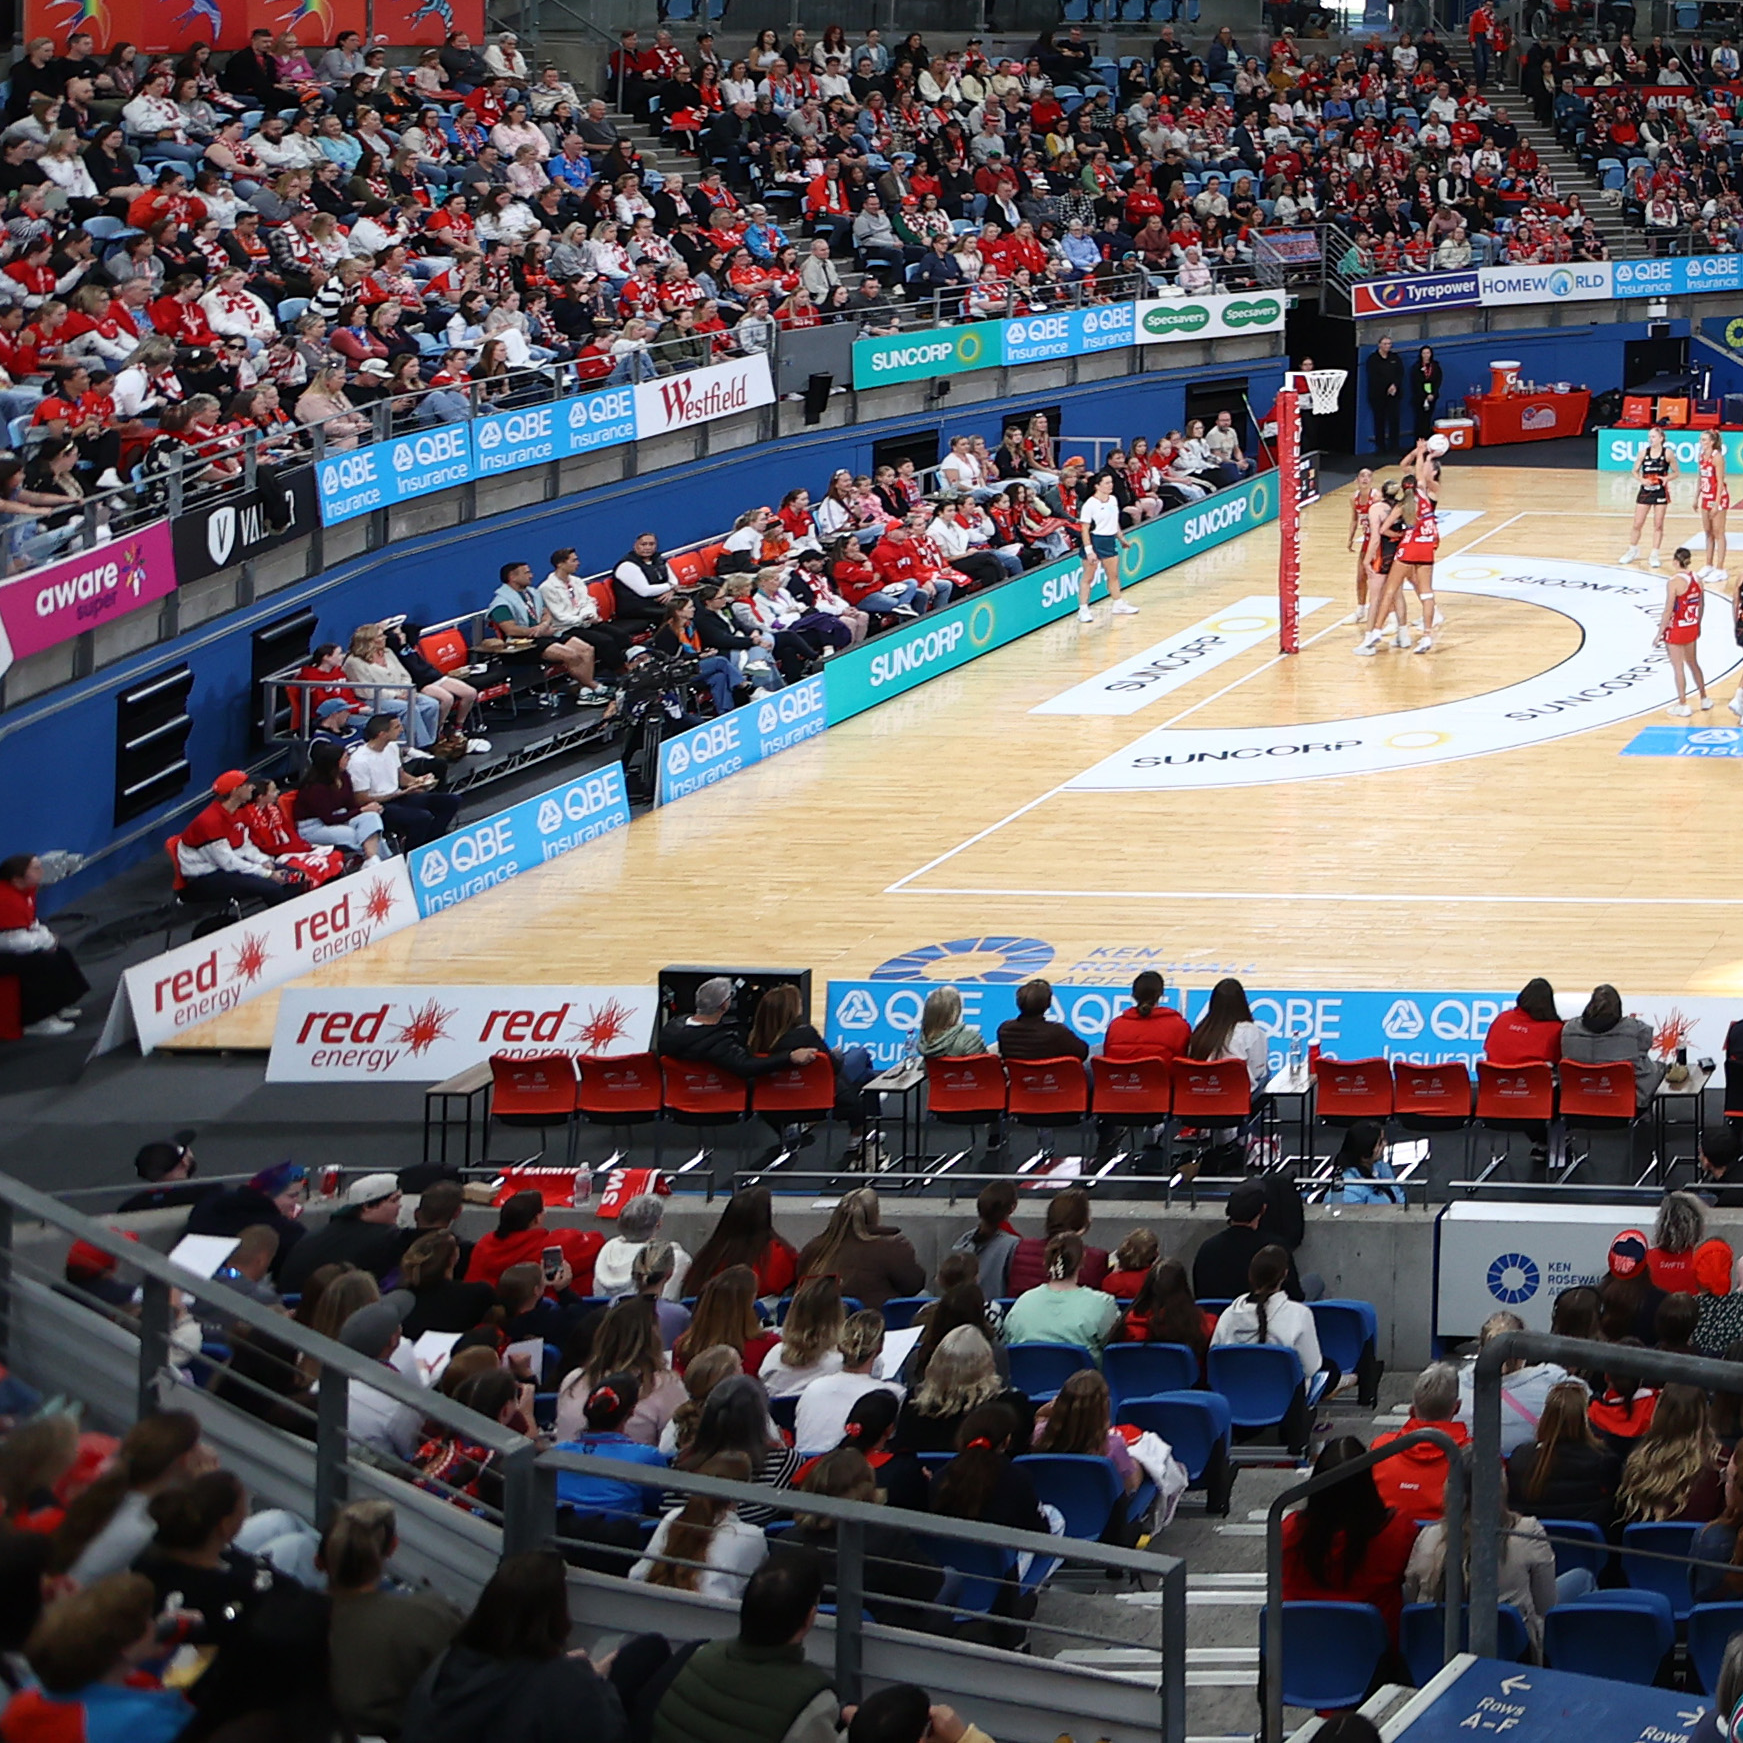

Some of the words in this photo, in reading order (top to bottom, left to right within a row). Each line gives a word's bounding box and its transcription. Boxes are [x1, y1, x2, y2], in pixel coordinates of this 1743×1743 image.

[1634, 262, 1671, 280] QBE
[1703, 258, 1738, 275] QBE
[1406, 279, 1475, 301] Tyrepower
[1027, 316, 1069, 340] QBE
[1097, 306, 1132, 330] QBE
[1147, 311, 1205, 329] Specsavers
[1226, 304, 1277, 322] Specsavers
[871, 341, 953, 371] SUNCORP
[588, 390, 633, 426] QBE
[659, 373, 748, 427] Westfield
[505, 409, 553, 444] QBE
[1450, 430, 1464, 445] G
[416, 428, 465, 465] QBE
[339, 451, 378, 489] QBE
[1184, 498, 1246, 544] SUNCORP
[35, 561, 118, 618] aware
[870, 620, 964, 686] SUNCORP
[1104, 636, 1227, 691] SUNCORP
[779, 679, 822, 723] QBE
[1505, 666, 1658, 721] SUNCORP
[691, 717, 741, 764] QBE
[1131, 740, 1362, 767] SUNCORP
[565, 770, 621, 820] QBE
[451, 817, 515, 873] QBE
[294, 893, 351, 951] red
[312, 925, 371, 964] energy
[1087, 948, 1163, 958] KEN
[154, 951, 219, 1013] red
[173, 983, 241, 1028] energy
[479, 1003, 570, 1043] red
[1247, 998, 1343, 1039] QBE
[296, 1004, 390, 1045] red
[311, 1047, 400, 1072] energy
[1548, 1262, 1571, 1272] KEN
[1460, 1712, 1519, 1734] A-F
[1477, 1696, 1526, 1716] Rows
[1640, 1726, 1690, 1743] Rows
